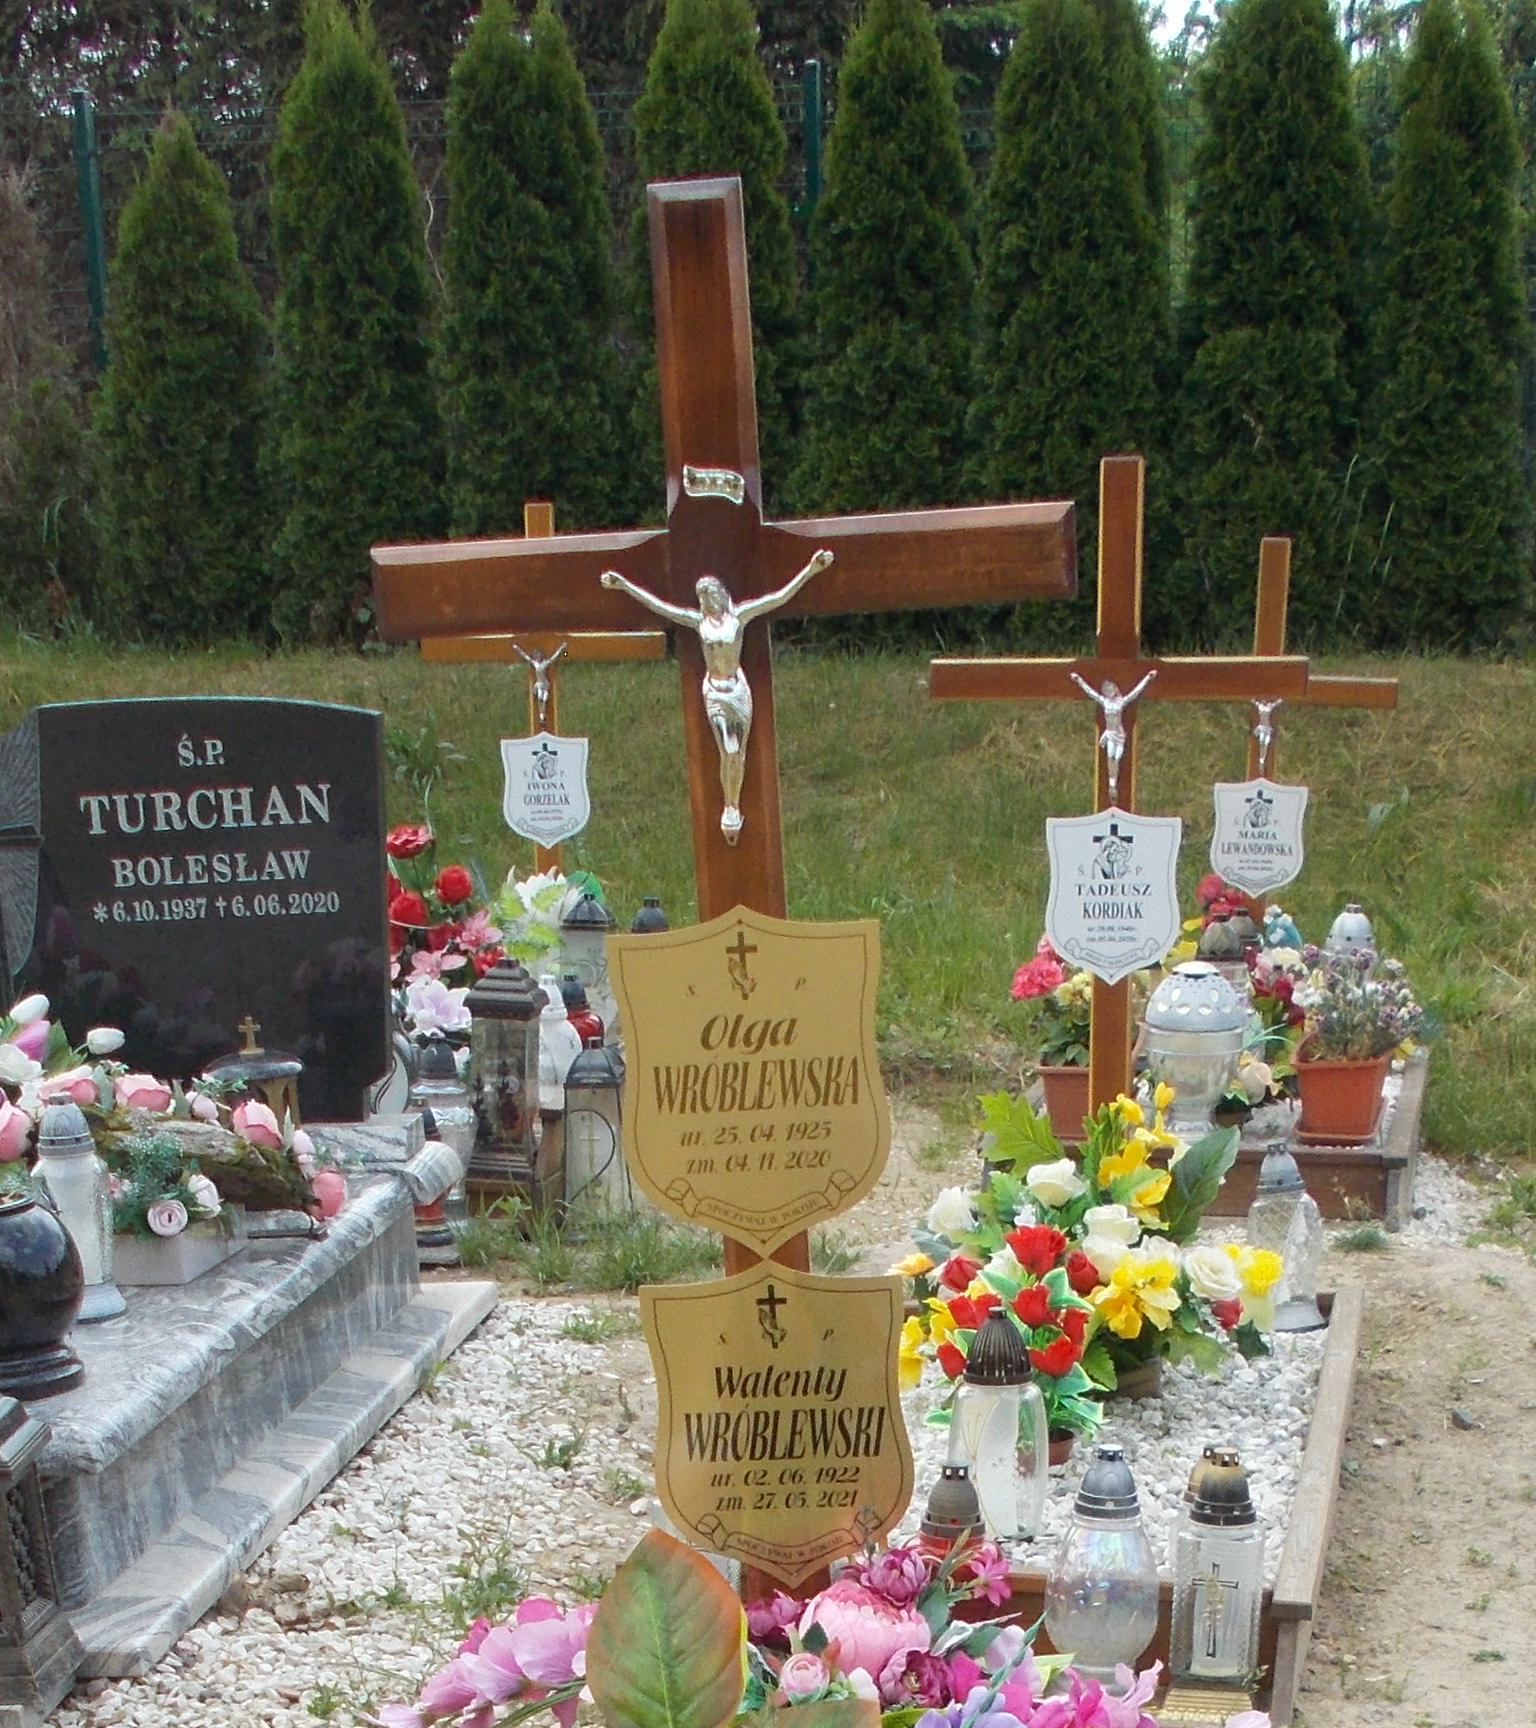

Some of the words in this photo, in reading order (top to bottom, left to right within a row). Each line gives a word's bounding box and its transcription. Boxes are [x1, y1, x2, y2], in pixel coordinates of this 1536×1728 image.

[527, 782, 566, 791] IWONA
[79, 783, 332, 836] TURCHAN
[1238, 830, 1278, 840] MARIA
[1221, 842, 1294, 856] LEWANDOWSKA
[111, 849, 311, 888] BOLESŁAW
[1075, 883, 1153, 897] TADEUSZ
[1082, 901, 1144, 920] KORDIAK
[699, 1013, 798, 1056] Olga
[653, 1052, 860, 1115] WRÓBLEWSKA
[785, 1120, 833, 1142] 1925
[784, 1149, 831, 1170] 2020
[714, 1363, 848, 1403] Walenty
[684, 1402, 886, 1464] WRÓBLEWSKI
[710, 1472, 735, 1488] ur.
[815, 1466, 861, 1485] 1922
[815, 1488, 859, 1509] 2021
